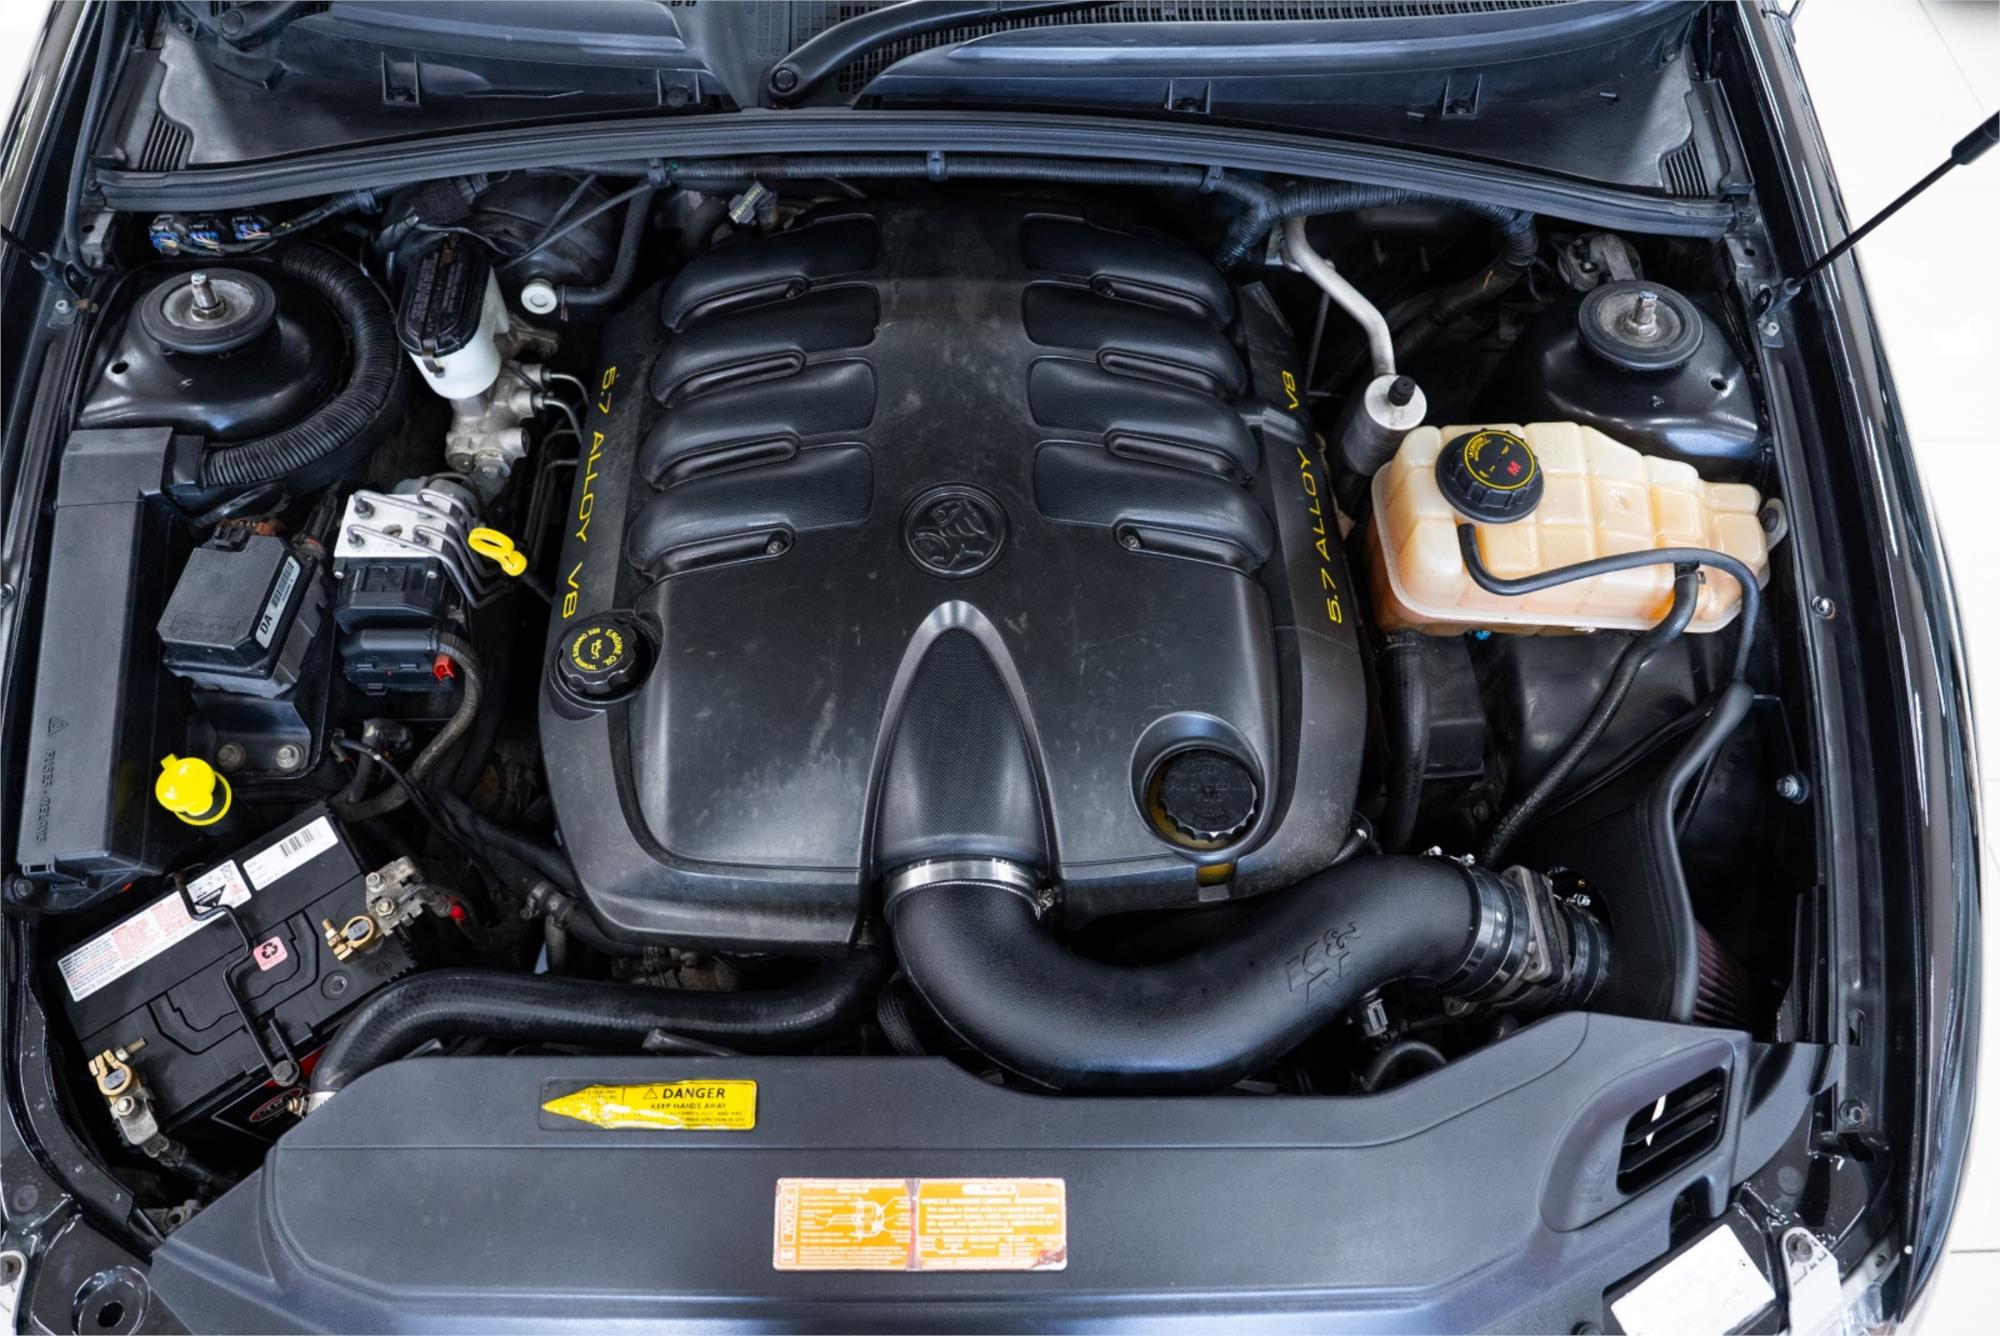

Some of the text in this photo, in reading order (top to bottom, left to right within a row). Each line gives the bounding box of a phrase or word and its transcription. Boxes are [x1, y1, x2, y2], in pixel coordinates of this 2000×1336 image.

[562, 365, 616, 619] 5.7 ALLOY V8
[1281, 370, 1343, 625] 5.7 ALLOY V8
[260, 614, 273, 635] DA
[602, 628, 623, 666] ENGINE OIL
[42, 750, 55, 786] FUSES
[662, 1087, 726, 1099] DANGER
